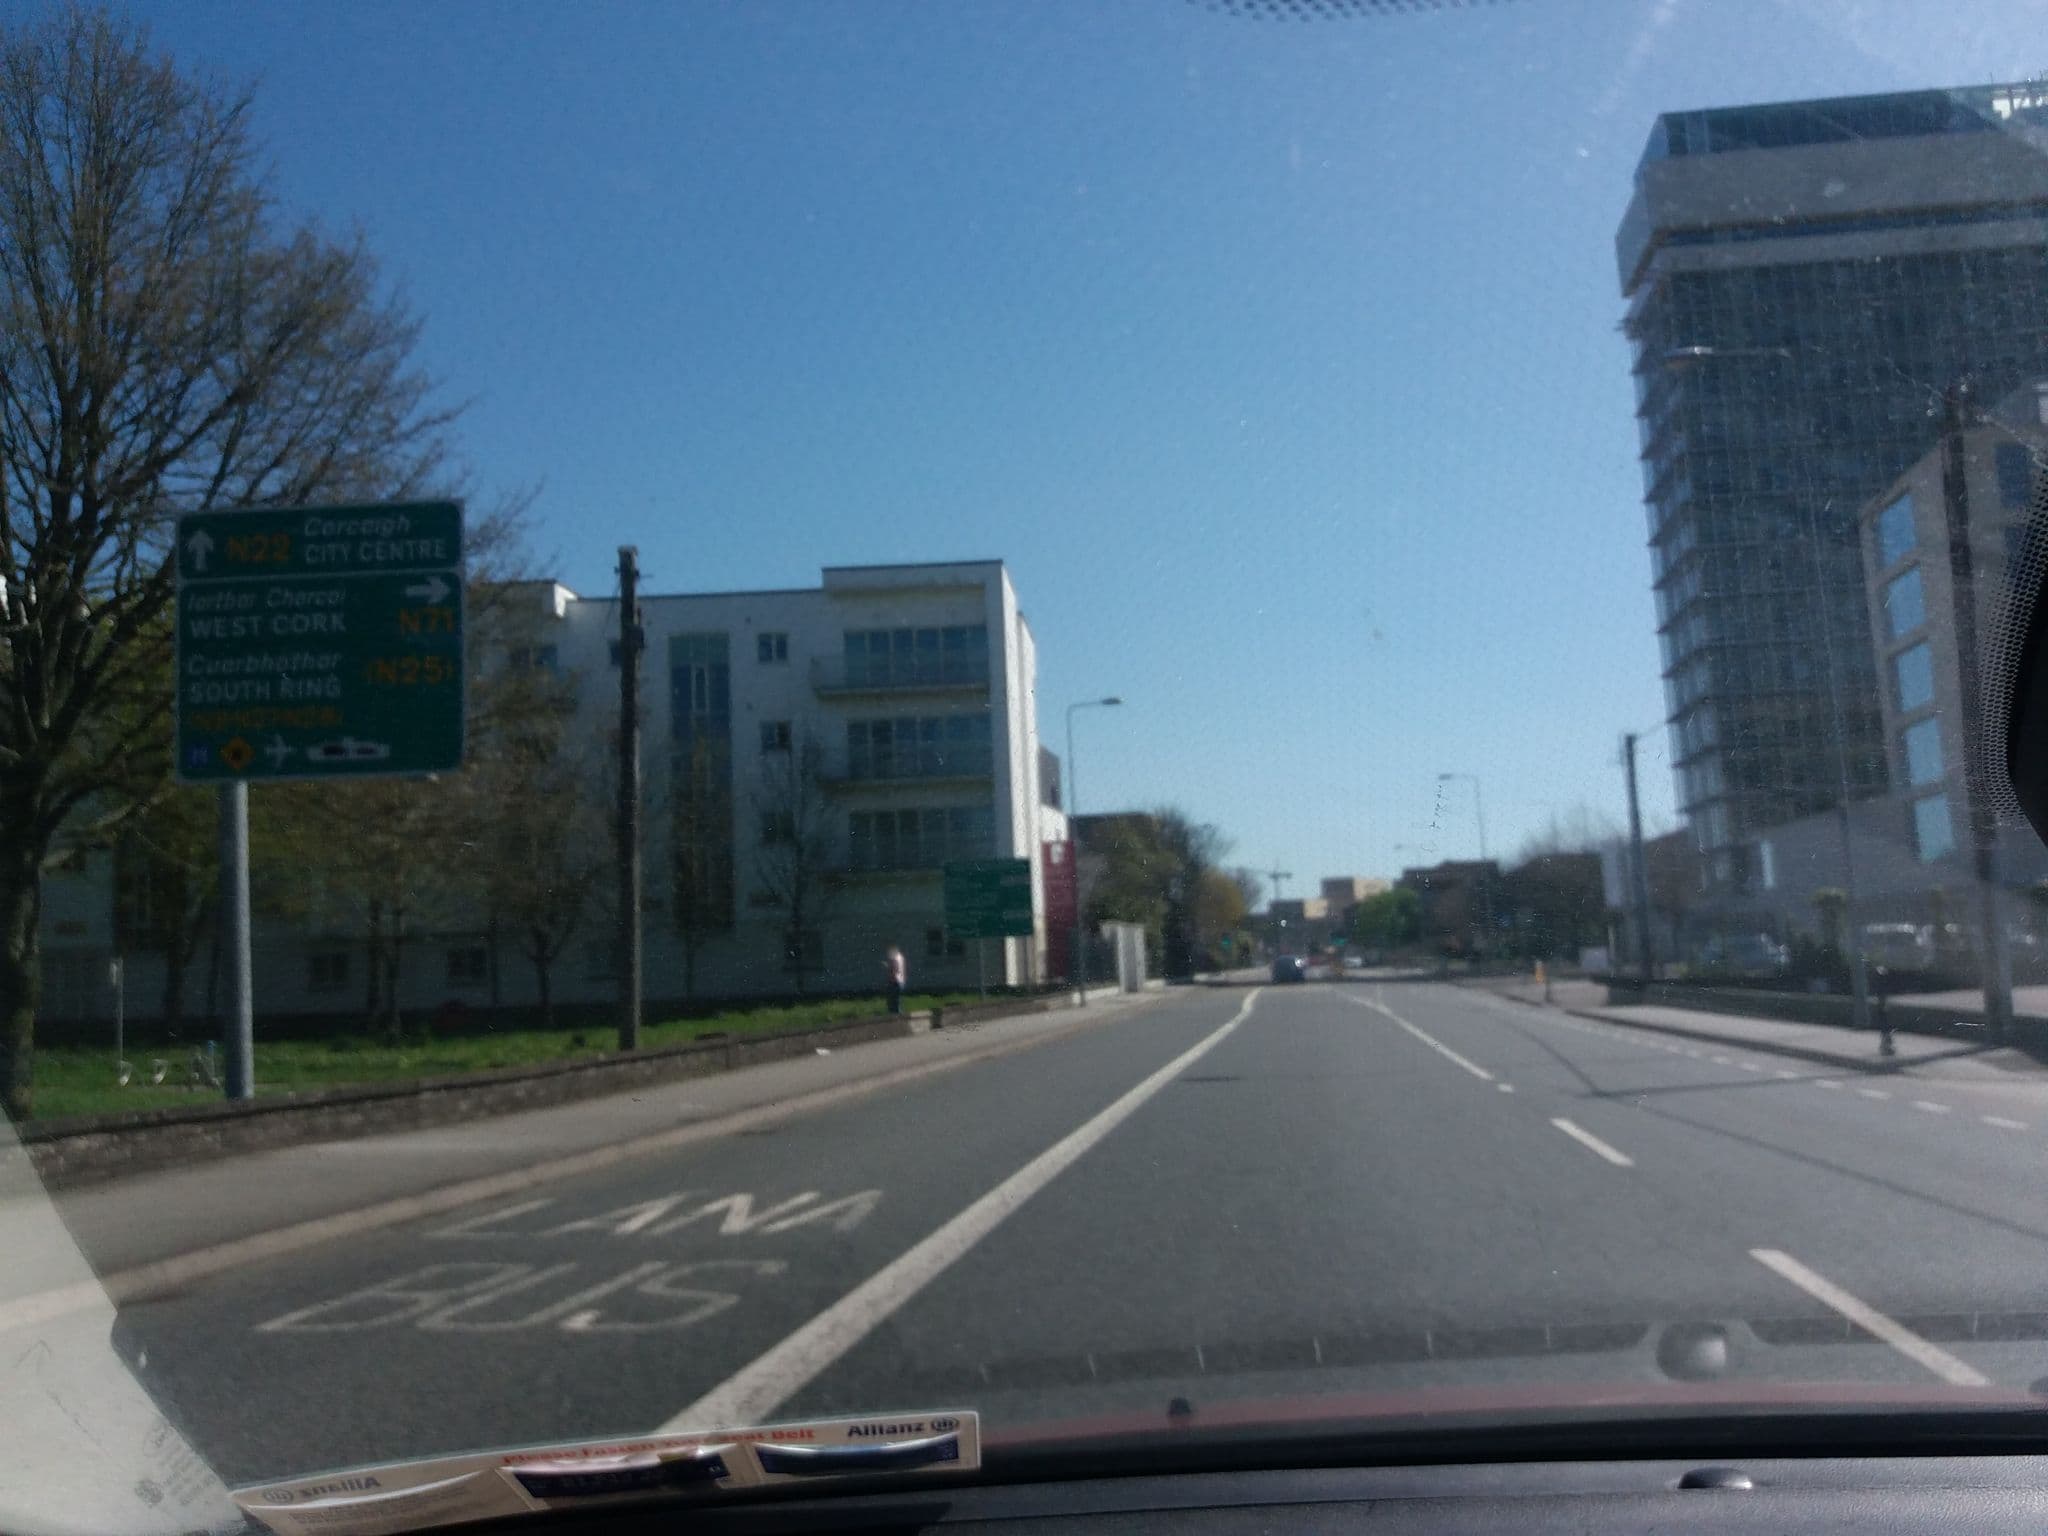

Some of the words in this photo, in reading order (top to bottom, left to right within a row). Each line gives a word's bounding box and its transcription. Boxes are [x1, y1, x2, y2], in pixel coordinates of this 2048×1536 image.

[228, 534, 292, 562] N22
[304, 543, 351, 563] CITY
[360, 538, 448, 562] CENTRE
[190, 615, 263, 639] WEST
[272, 611, 347, 635] CORK
[399, 608, 454, 634] N71
[190, 680, 271, 703] SOUTH
[280, 675, 342, 699] RING
[253, 1260, 790, 1332] BUS
[848, 1422, 926, 1439] Allianz
